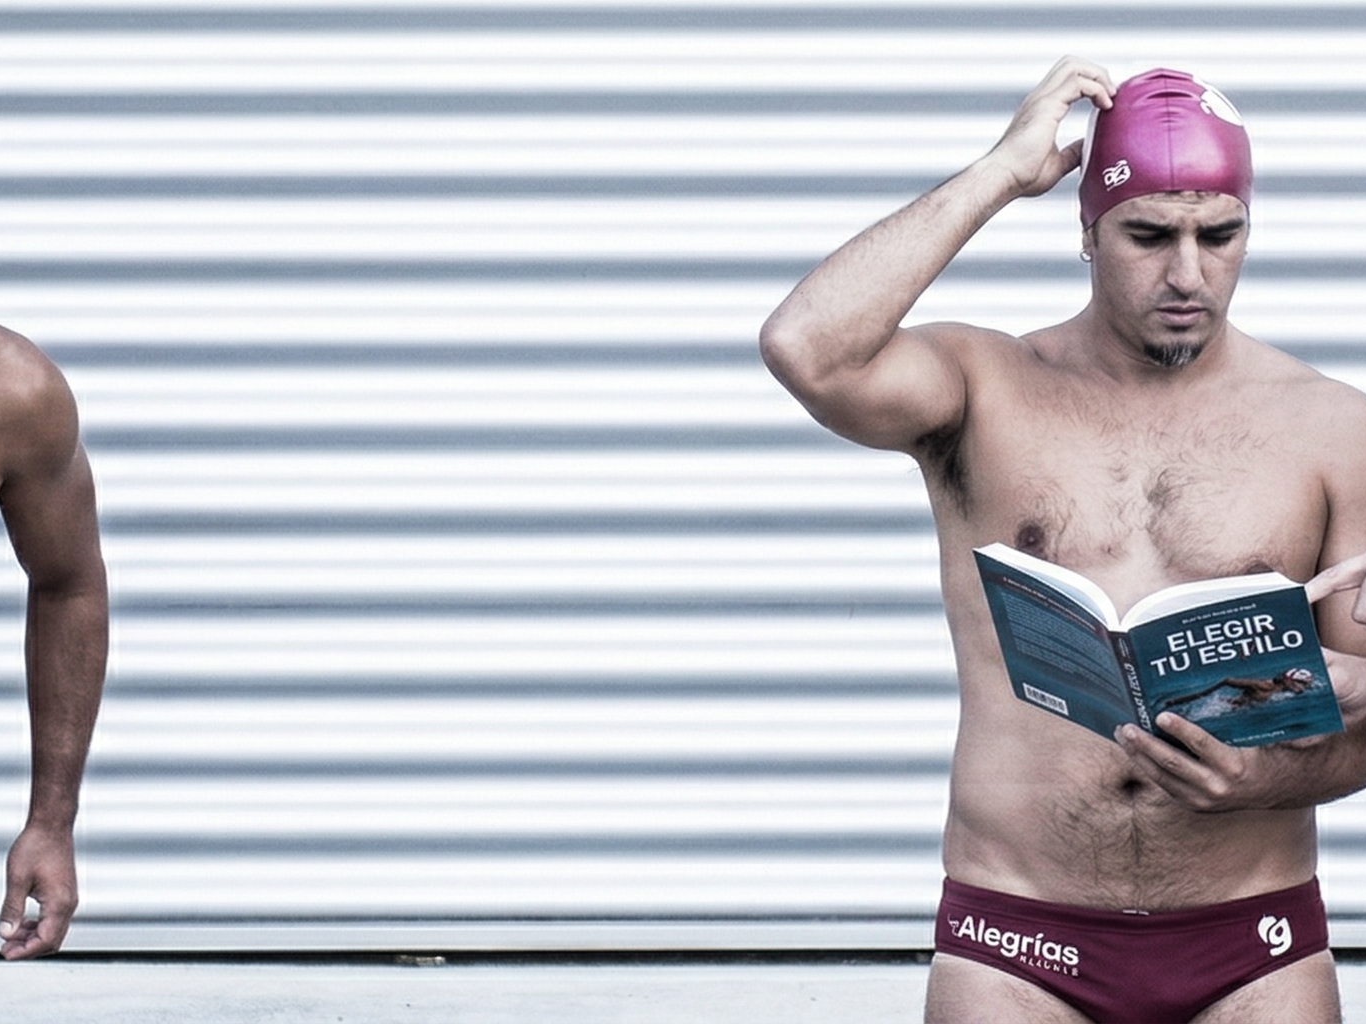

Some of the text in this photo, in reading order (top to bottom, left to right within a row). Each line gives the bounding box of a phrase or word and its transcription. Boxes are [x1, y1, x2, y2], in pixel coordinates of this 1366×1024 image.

[1150, 630, 1304, 676] TU ESTILO
[1167, 614, 1275, 652] ELEGIR
[958, 915, 1079, 965] Alegrías
